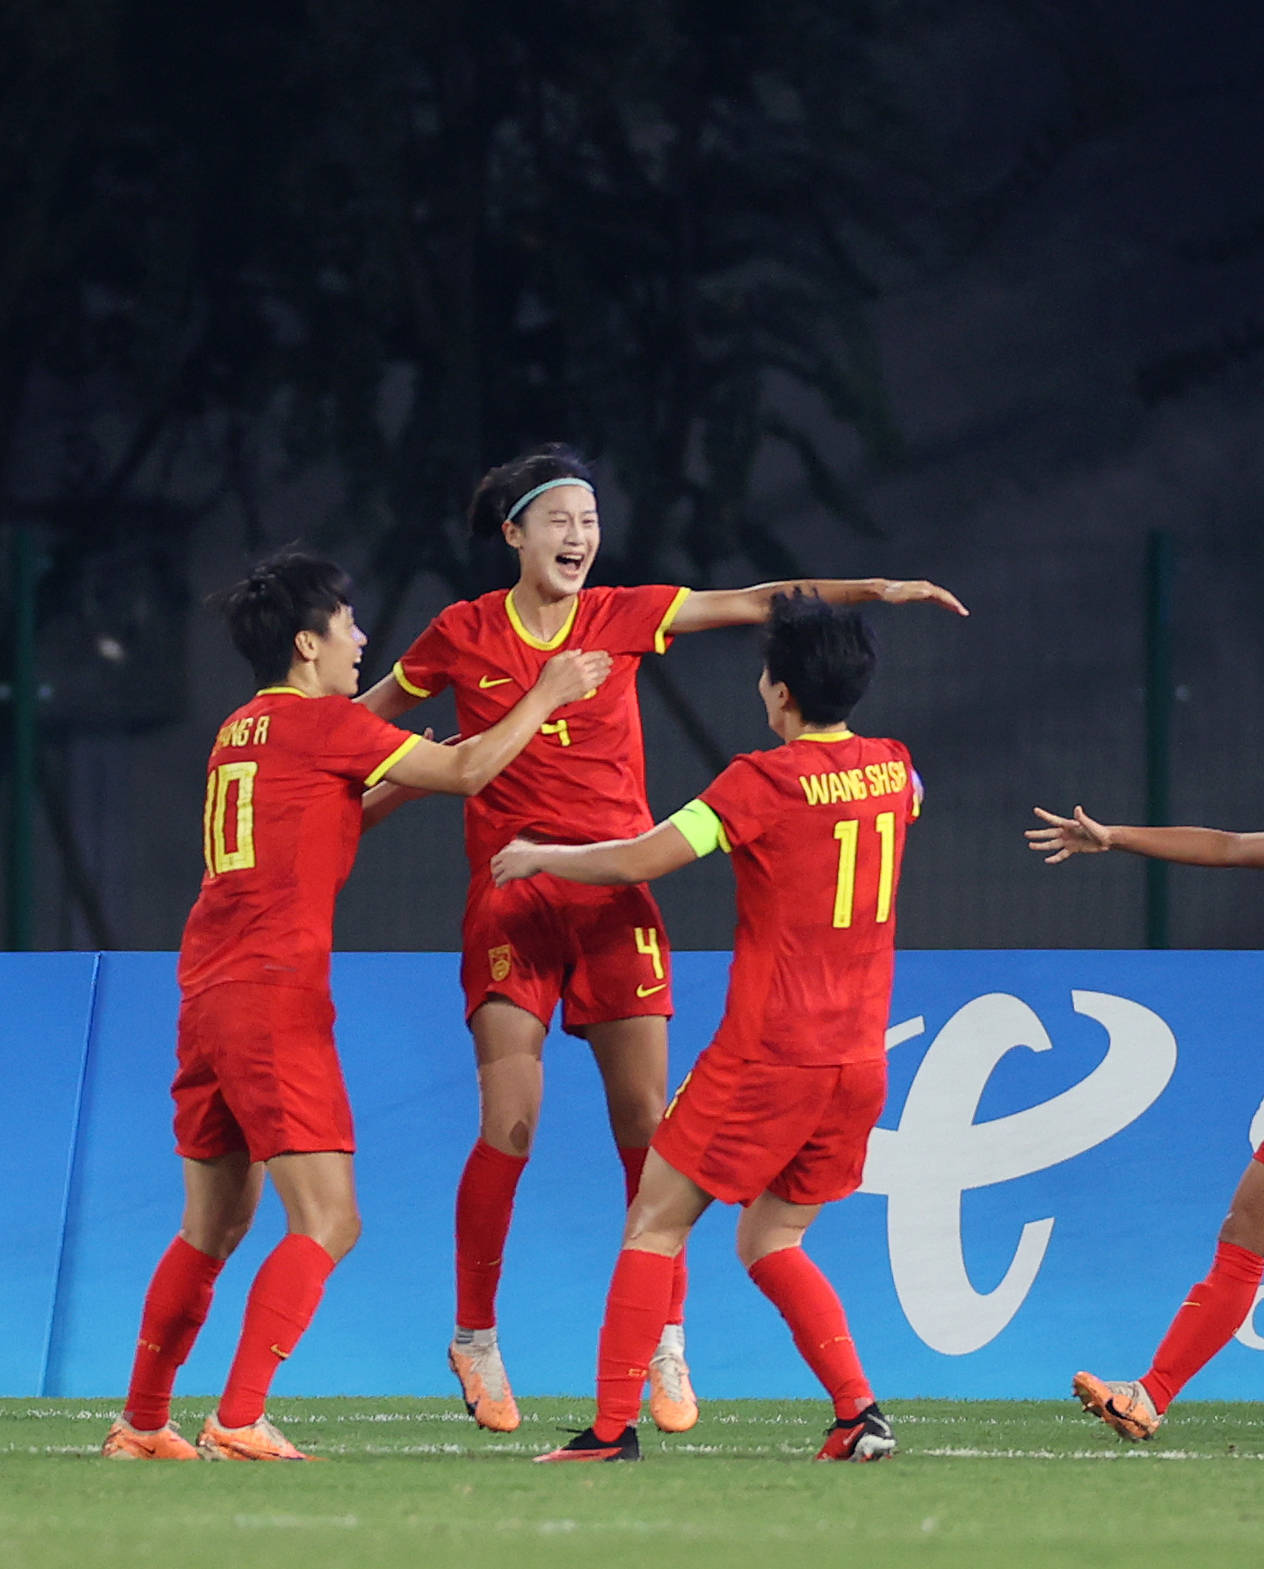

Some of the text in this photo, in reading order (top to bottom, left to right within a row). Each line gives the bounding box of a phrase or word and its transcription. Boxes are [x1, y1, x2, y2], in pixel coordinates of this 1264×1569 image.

[204, 761, 259, 879] 10
[800, 768, 868, 806] WANG
[833, 812, 896, 928] 11
[634, 927, 664, 980] 4
